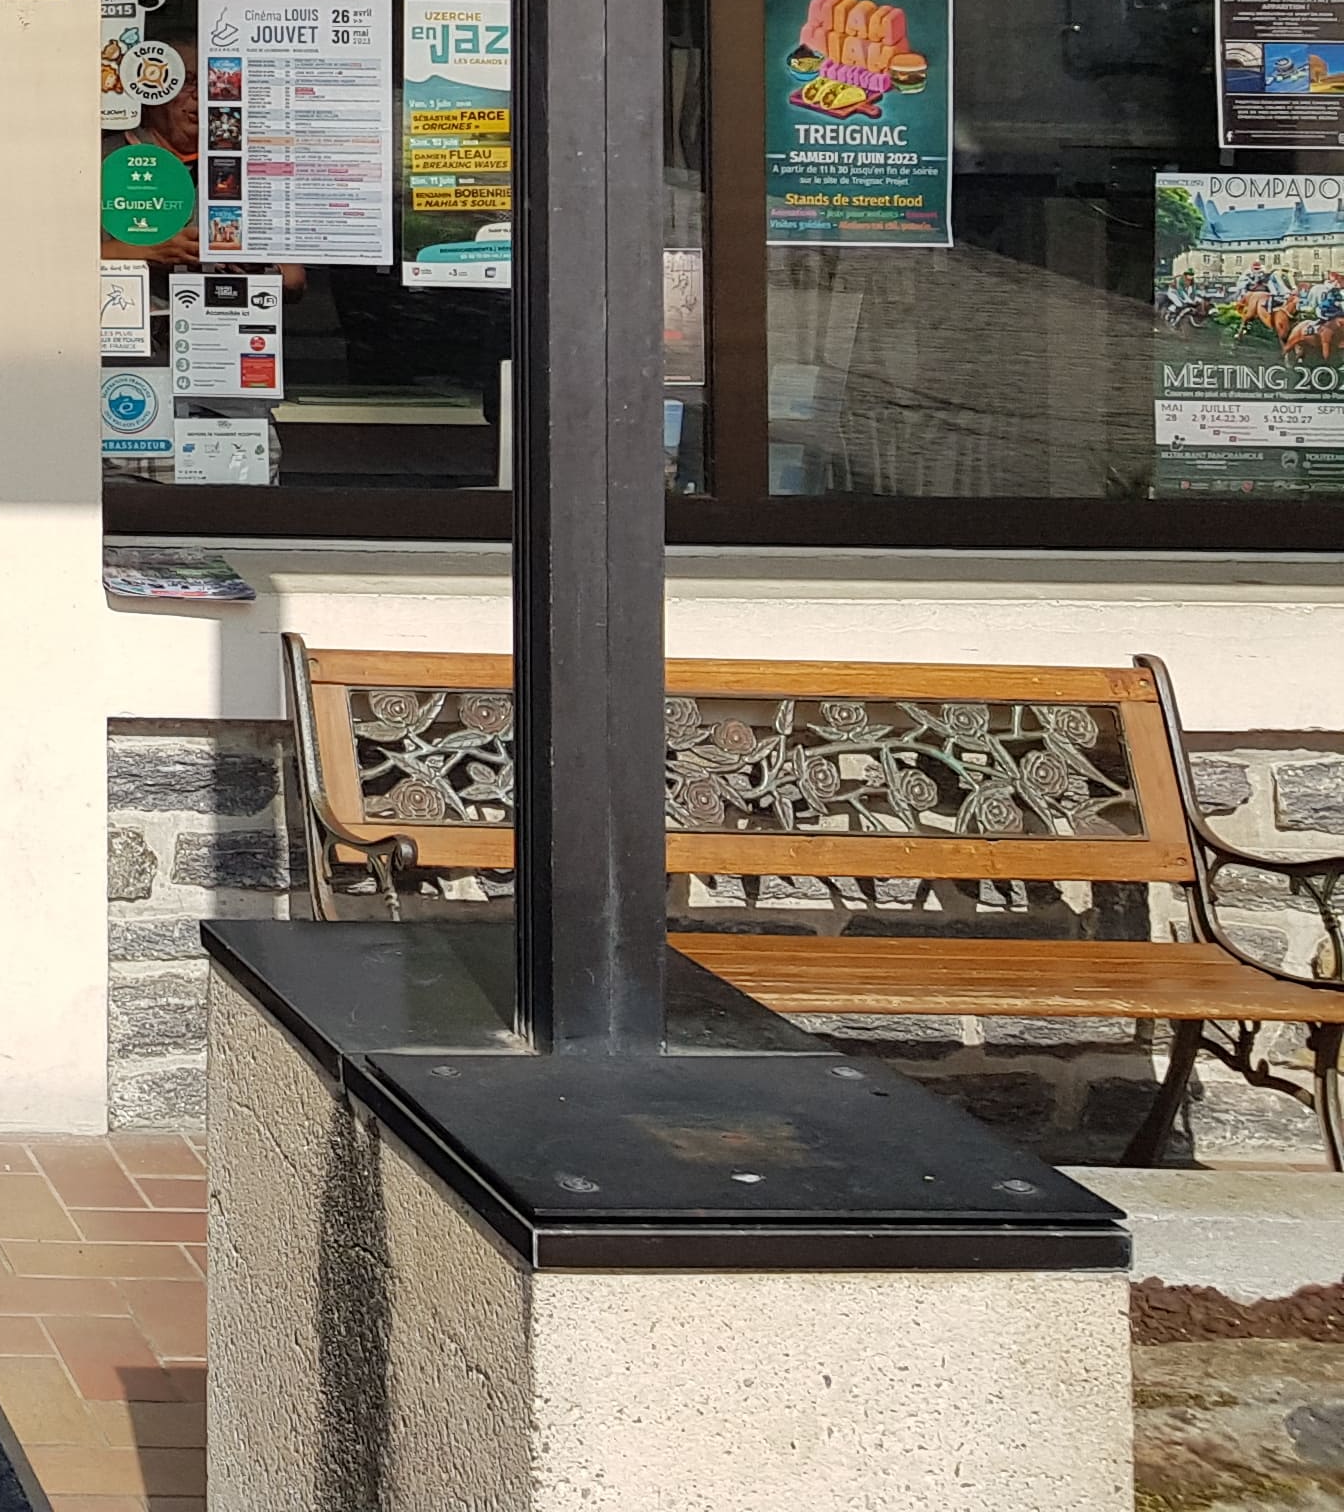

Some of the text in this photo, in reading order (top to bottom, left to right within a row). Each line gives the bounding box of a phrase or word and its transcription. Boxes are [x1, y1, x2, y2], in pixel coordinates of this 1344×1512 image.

[285, 9, 319, 22] LOUIS
[331, 8, 372, 23] 26 avril
[425, 11, 481, 21] UZERCHE
[251, 26, 319, 44] JOUVET
[331, 29, 369, 44] 30 mai
[412, 26, 436, 40] en
[460, 110, 505, 121] FARGE
[422, 122, 473, 131] ORIGINES
[794, 124, 908, 146] TREIGNAC
[449, 149, 492, 160] FLEAU
[789, 151, 918, 165] SAMEDI 17 JUIN 2023
[127, 157, 157, 167] 2023
[422, 160, 509, 169] BREAKING WAVES
[781, 165, 805, 176] partir
[807, 165, 817, 173] de
[829, 165, 836, 173] h
[837, 166, 849, 174] 30
[850, 166, 885, 176] jusqu'en
[886, 166, 897, 175] fin
[899, 166, 910, 175] de
[912, 166, 939, 175] soirée
[839, 176, 849, 184] de
[852, 176, 883, 186] Treignac
[885, 177, 909, 187] Projet
[470, 199, 497, 208] SOUL
[785, 193, 923, 207] Stands de street food
[1163, 364, 1289, 390] MEETING
[1161, 404, 1183, 413] MAI
[1200, 404, 1241, 414] JUILLET
[1271, 405, 1304, 414] AOUT
